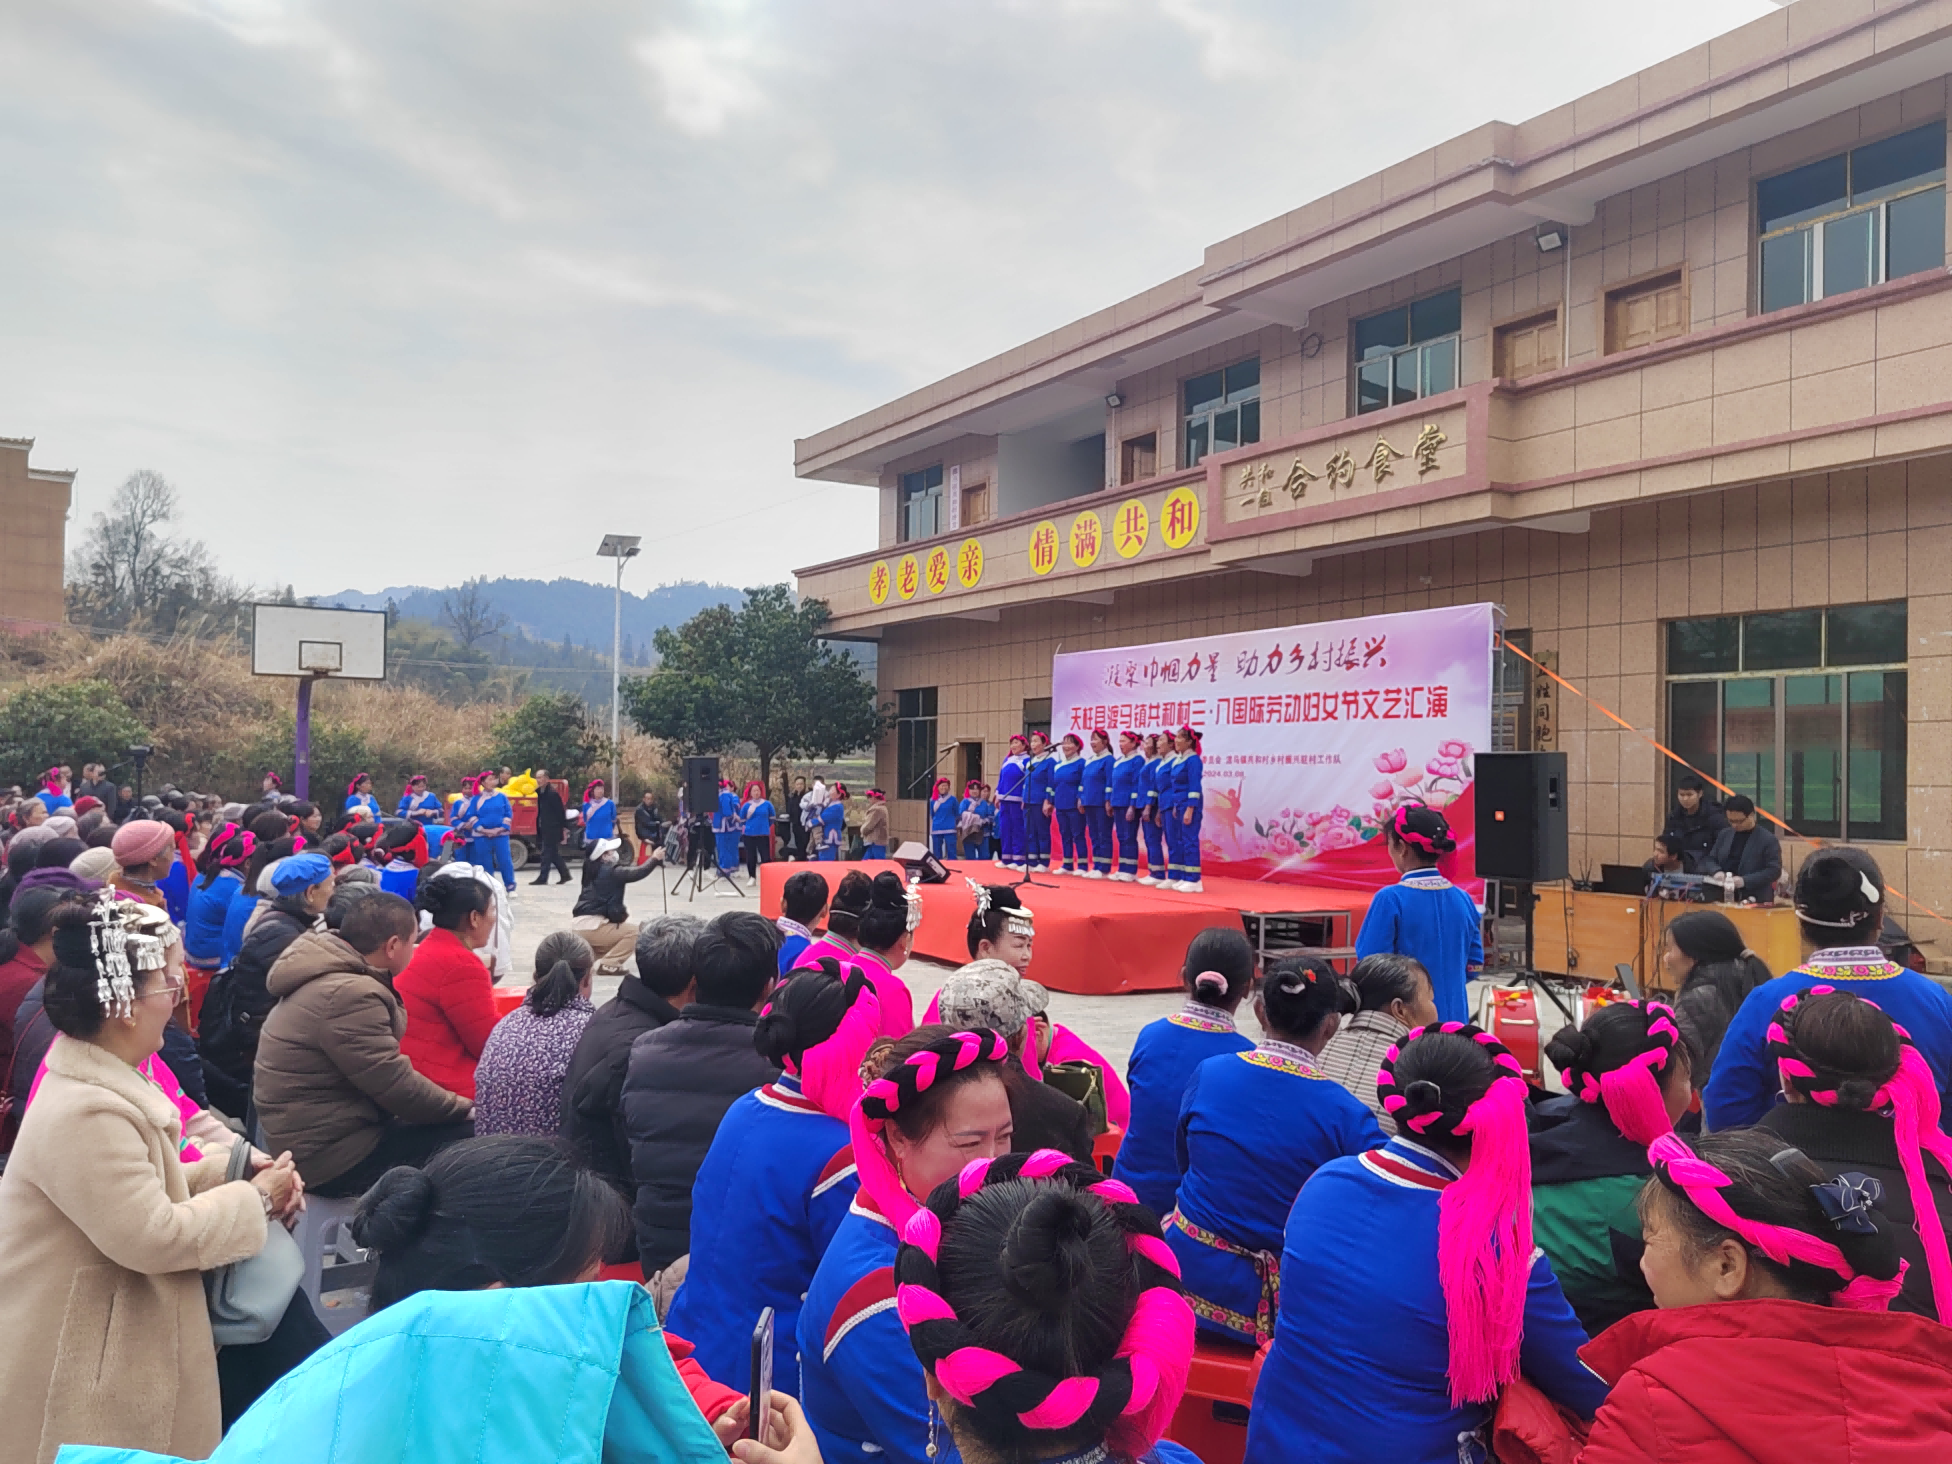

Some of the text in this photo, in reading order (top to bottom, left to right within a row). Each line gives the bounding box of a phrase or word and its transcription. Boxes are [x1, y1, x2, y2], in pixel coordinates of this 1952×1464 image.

[873, 544, 979, 599] 孝老爱亲
[1033, 497, 1193, 568] 情满共和
[1236, 634, 1387, 679] 助力乡村振兴
